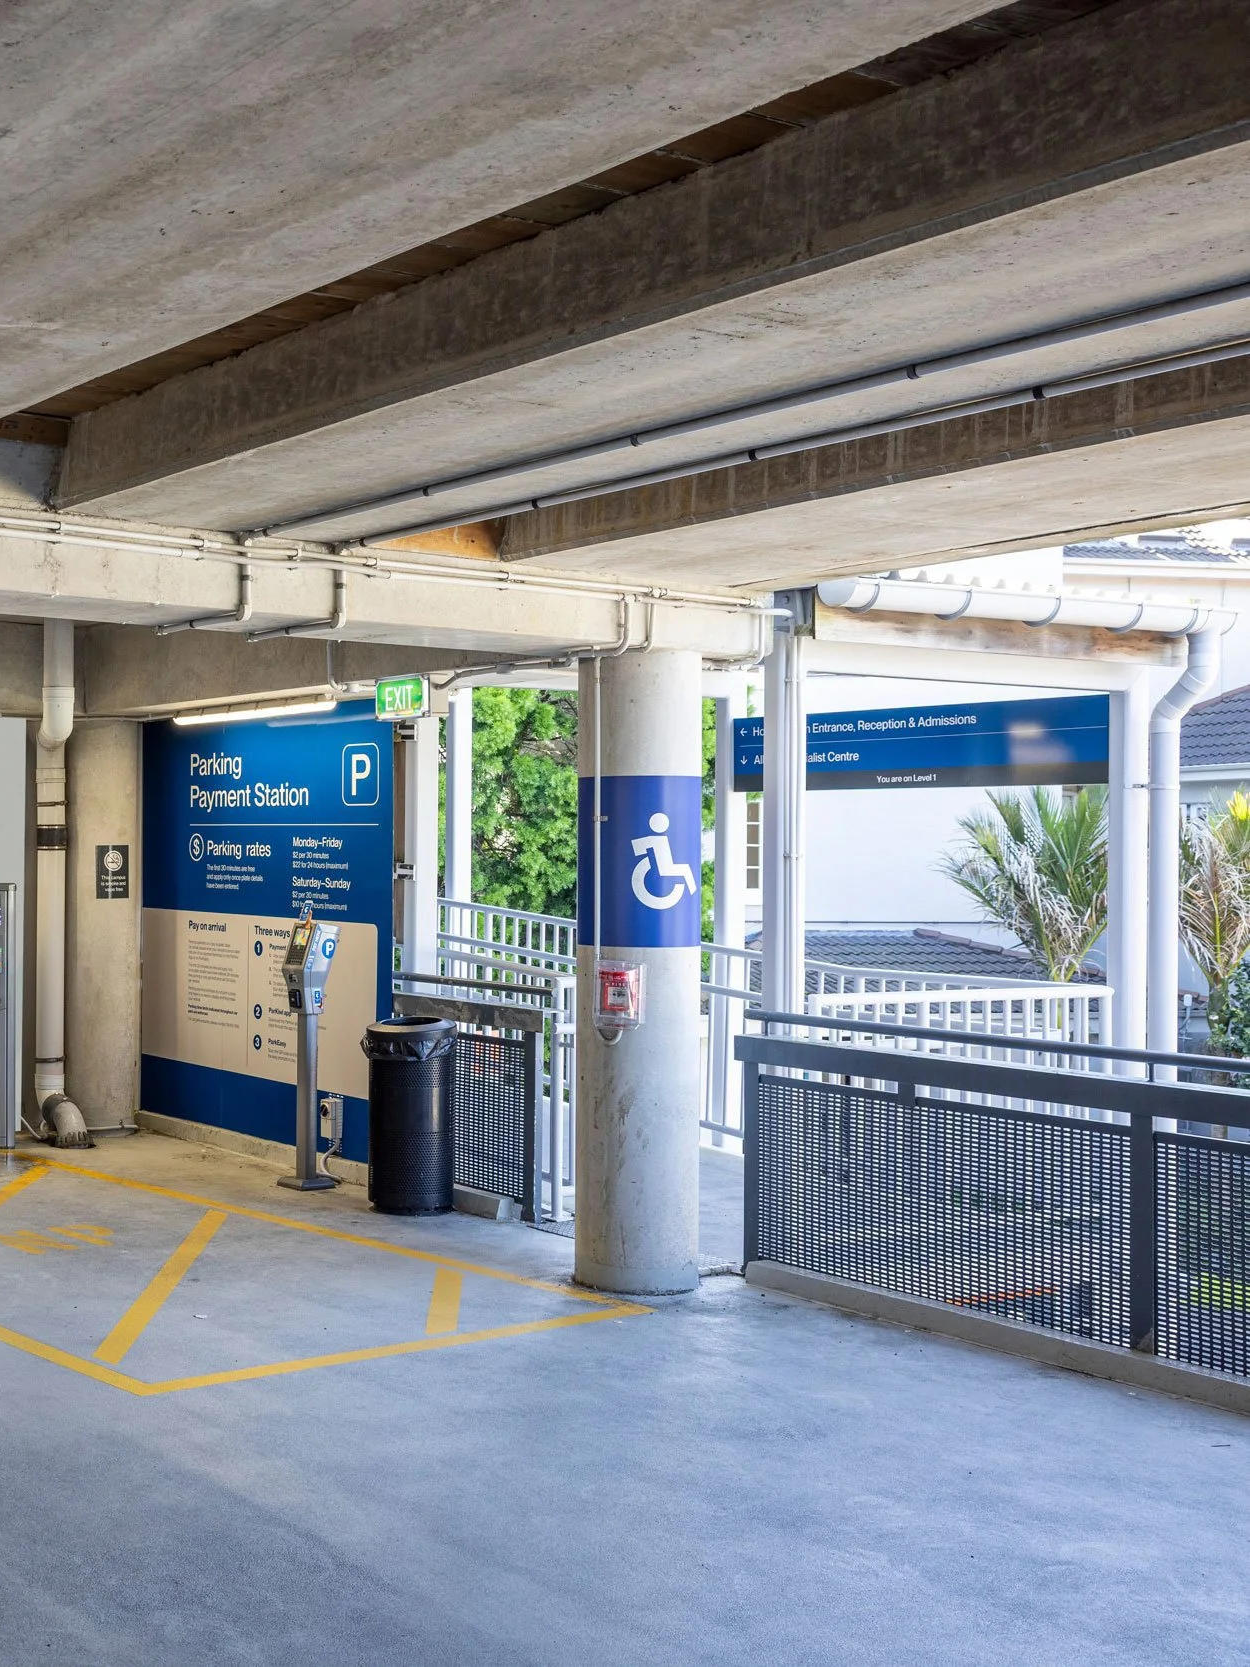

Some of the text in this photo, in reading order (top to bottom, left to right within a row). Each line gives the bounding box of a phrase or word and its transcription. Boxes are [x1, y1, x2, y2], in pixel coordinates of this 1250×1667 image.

[385, 684, 414, 711] EXIT
[813, 721, 856, 733] Entrance,
[857, 718, 906, 734] Reception
[908, 717, 917, 728] &
[918, 714, 977, 728] Admissions
[827, 751, 860, 763] Centre
[190, 753, 242, 780] Parking
[351, 753, 371, 796] P
[877, 775, 890, 784] You
[891, 775, 902, 783] are
[903, 775, 912, 783] on
[913, 774, 932, 783] Level
[190, 782, 309, 812] Payment Station
[207, 840, 242, 860] Parking
[246, 841, 272, 857] rates
[292, 836, 343, 850] Monday–Friday
[292, 851, 298, 859] $2
[306, 851, 312, 859] 30
[307, 861, 313, 869] 24
[292, 876, 351, 891] Saturday–Sunday
[312, 892, 329, 900] minutes
[189, 920, 199, 931] Pay
[208, 923, 226, 932] arrival
[254, 925, 291, 939] Three ways
[269, 943, 287, 951] Payment
[326, 942, 334, 956] P
[268, 1038, 287, 1048] ParkEasy
